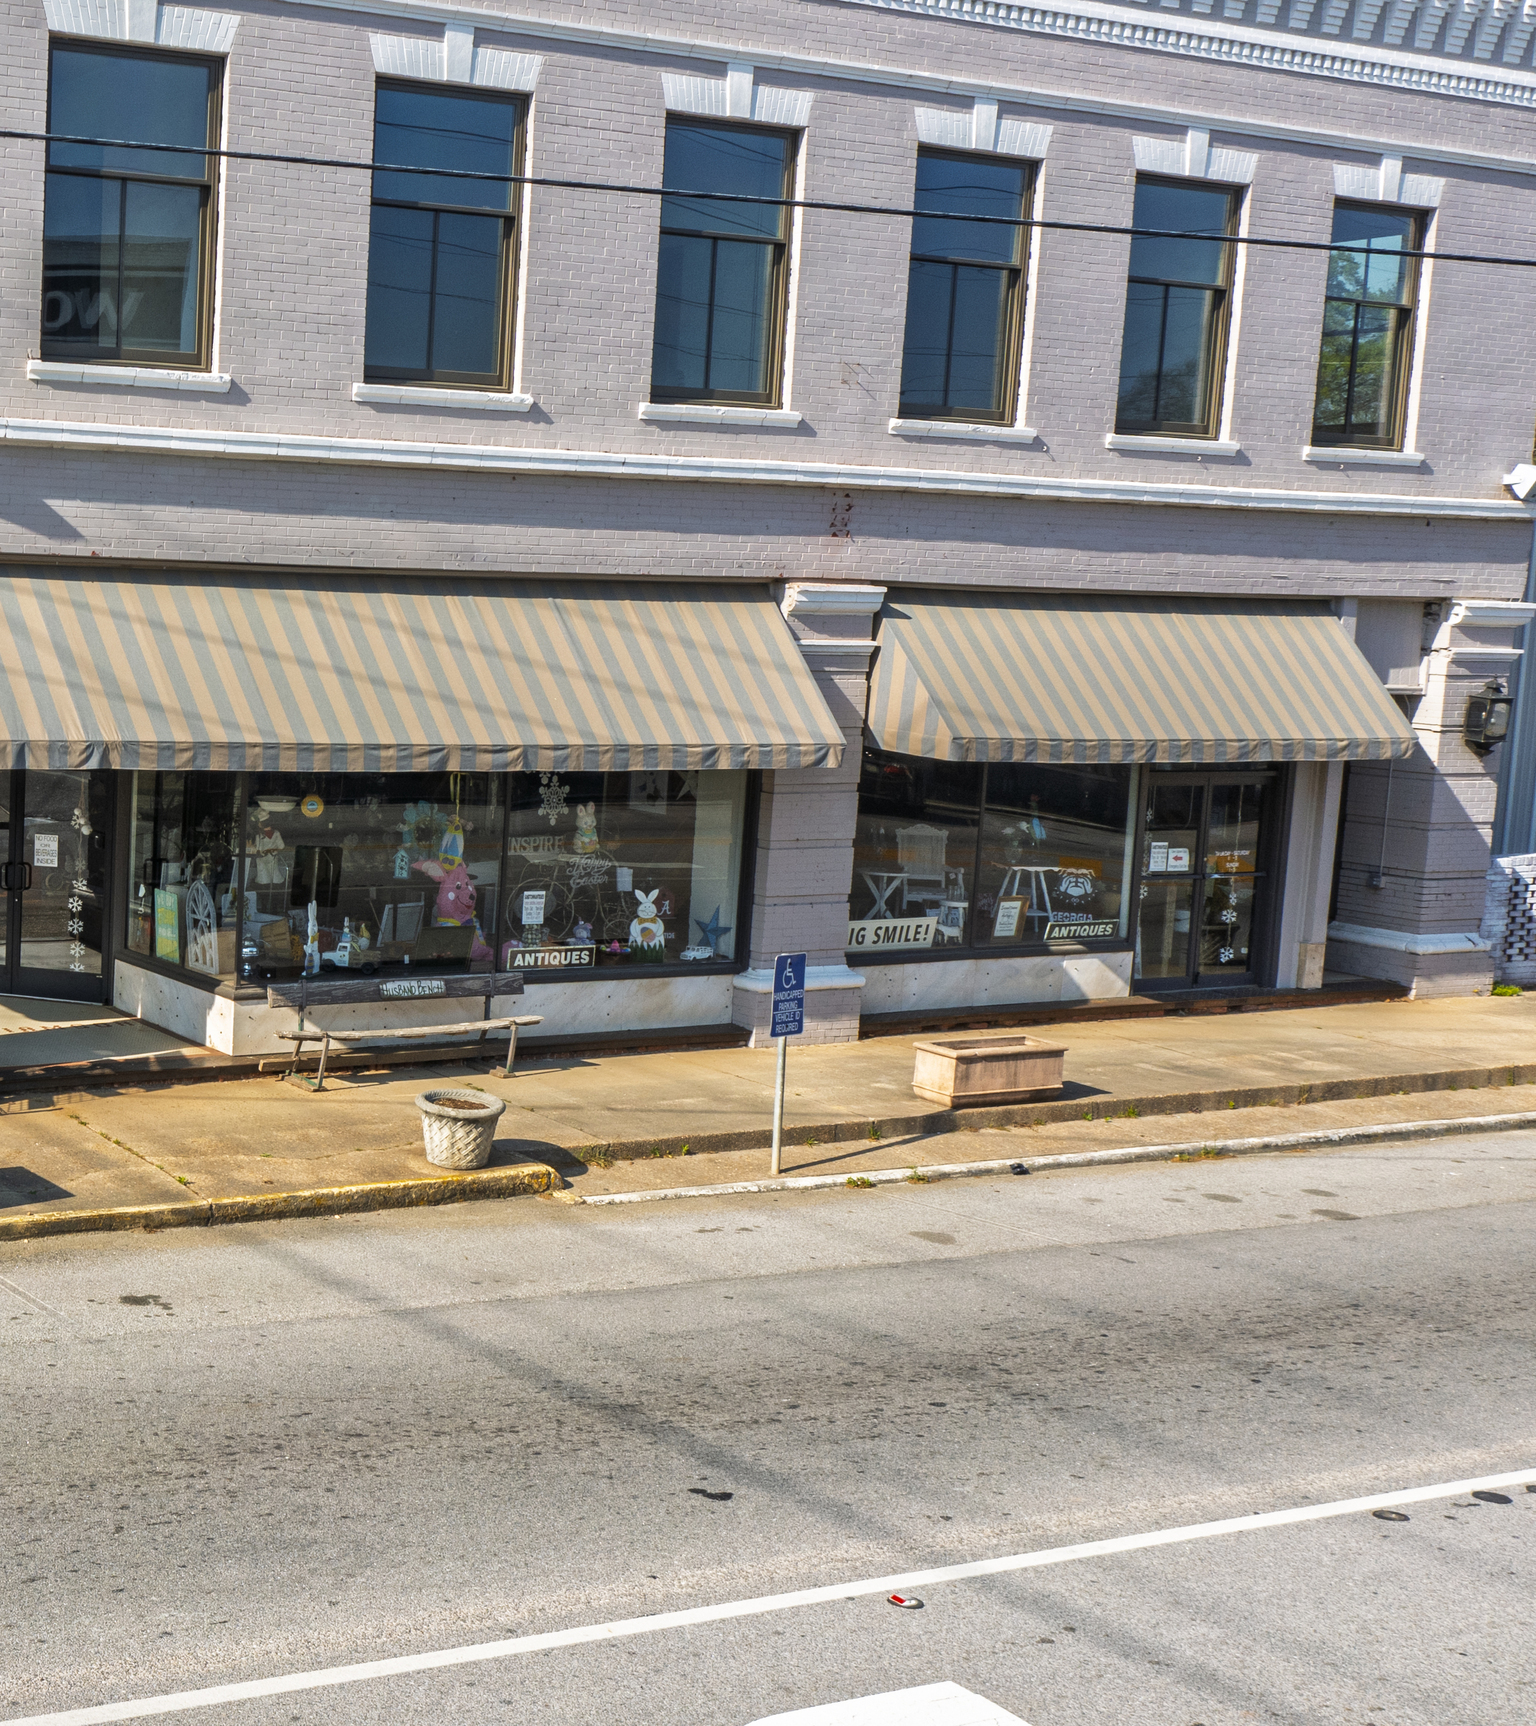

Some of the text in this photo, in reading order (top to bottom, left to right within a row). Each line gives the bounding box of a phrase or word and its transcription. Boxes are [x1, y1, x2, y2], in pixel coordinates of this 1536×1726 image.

[44, 835, 57, 843] FOOD
[566, 854, 612, 875] Happy
[570, 875, 609, 888] Easter
[1051, 911, 1094, 922] GEORGIA
[872, 924, 930, 945] SMILE!
[1051, 924, 1114, 938] ANTIQUES
[514, 951, 590, 966] ANTIQUES
[774, 988, 804, 1001] HANDICAPPED
[778, 1000, 798, 1012] PARKING
[775, 1011, 801, 1023] VEHICLE ID
[775, 1022, 799, 1034] REQUIRED
